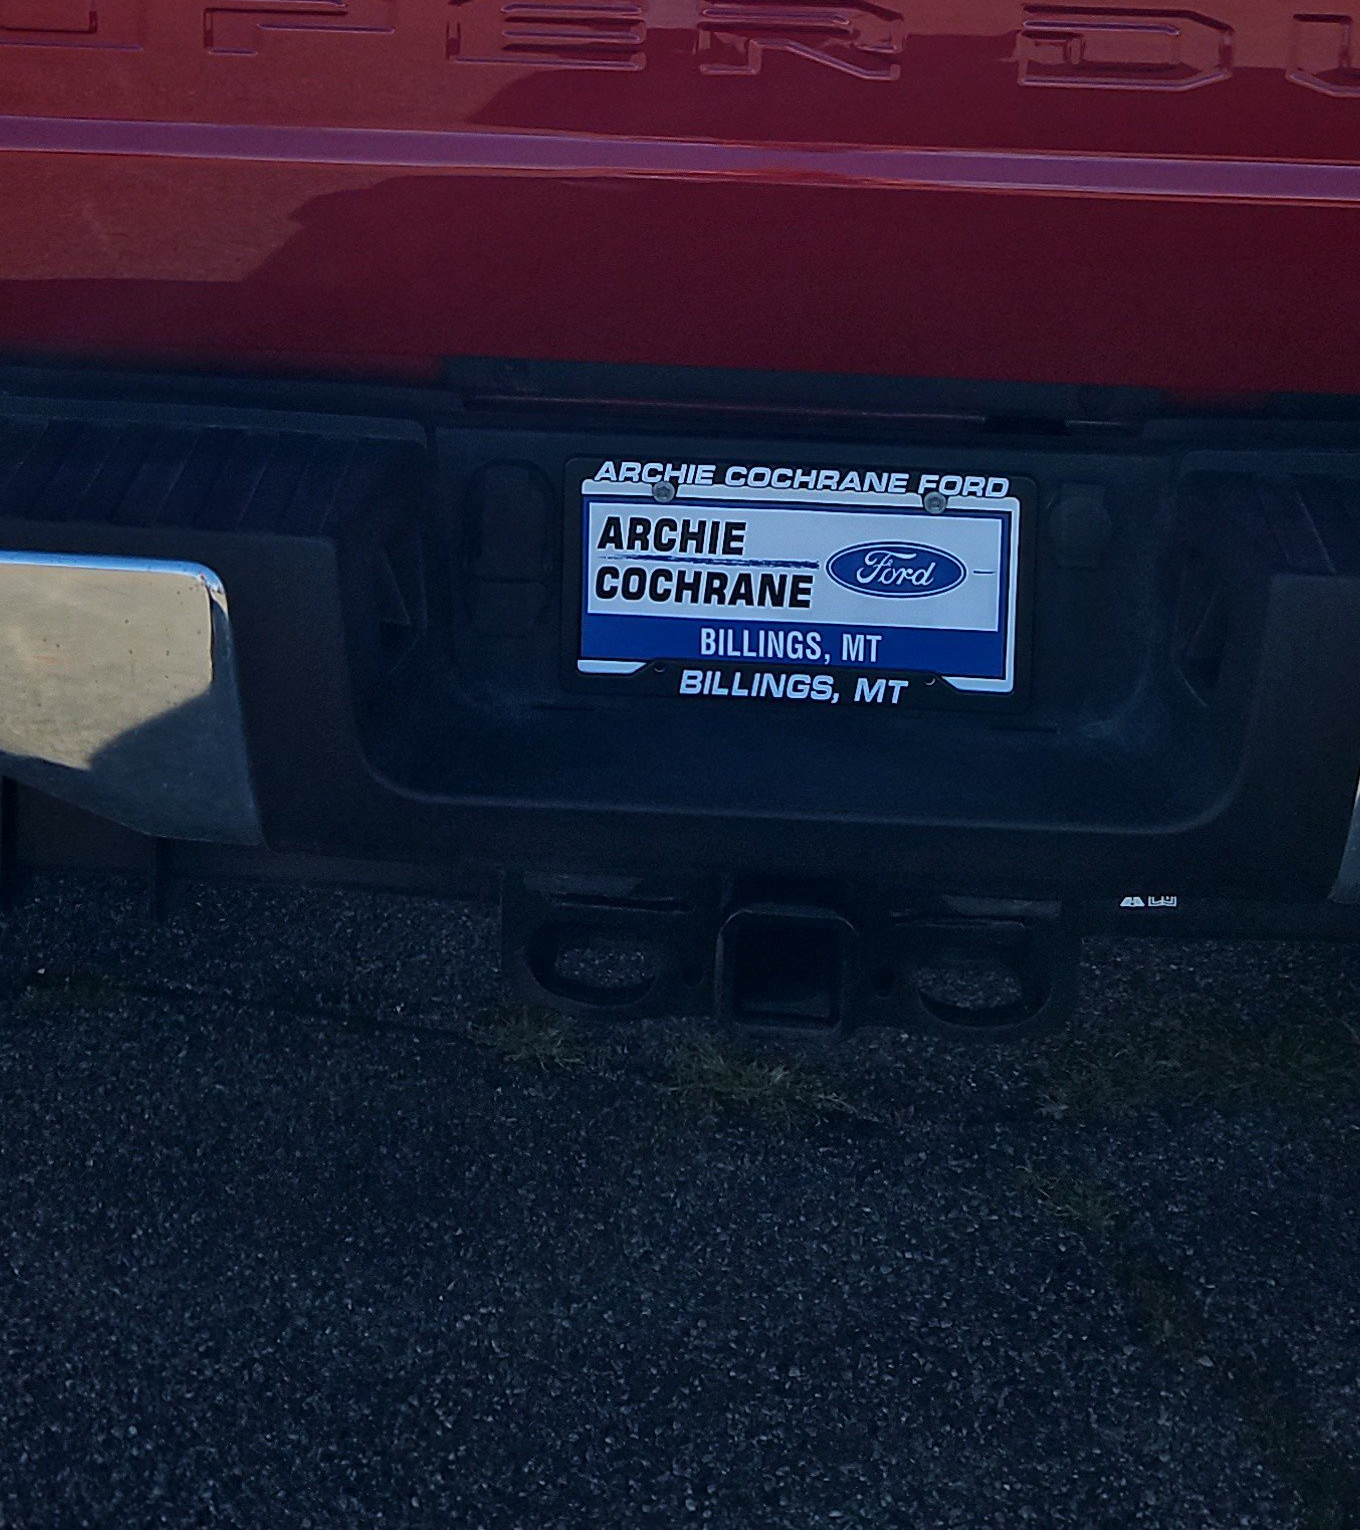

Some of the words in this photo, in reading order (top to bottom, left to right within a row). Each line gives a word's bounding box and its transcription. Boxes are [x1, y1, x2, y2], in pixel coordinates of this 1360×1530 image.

[594, 460, 716, 485] ARCHIE
[724, 466, 909, 494] COCHRANE
[917, 473, 1010, 498] FORD
[597, 515, 748, 556] ARCHIE
[855, 550, 935, 588] Ford
[595, 568, 815, 610] COCHRANE
[700, 627, 831, 664] BILLINGS,
[842, 633, 882, 663] MT
[678, 670, 840, 704] BILLINGS,
[854, 677, 909, 705] MT
